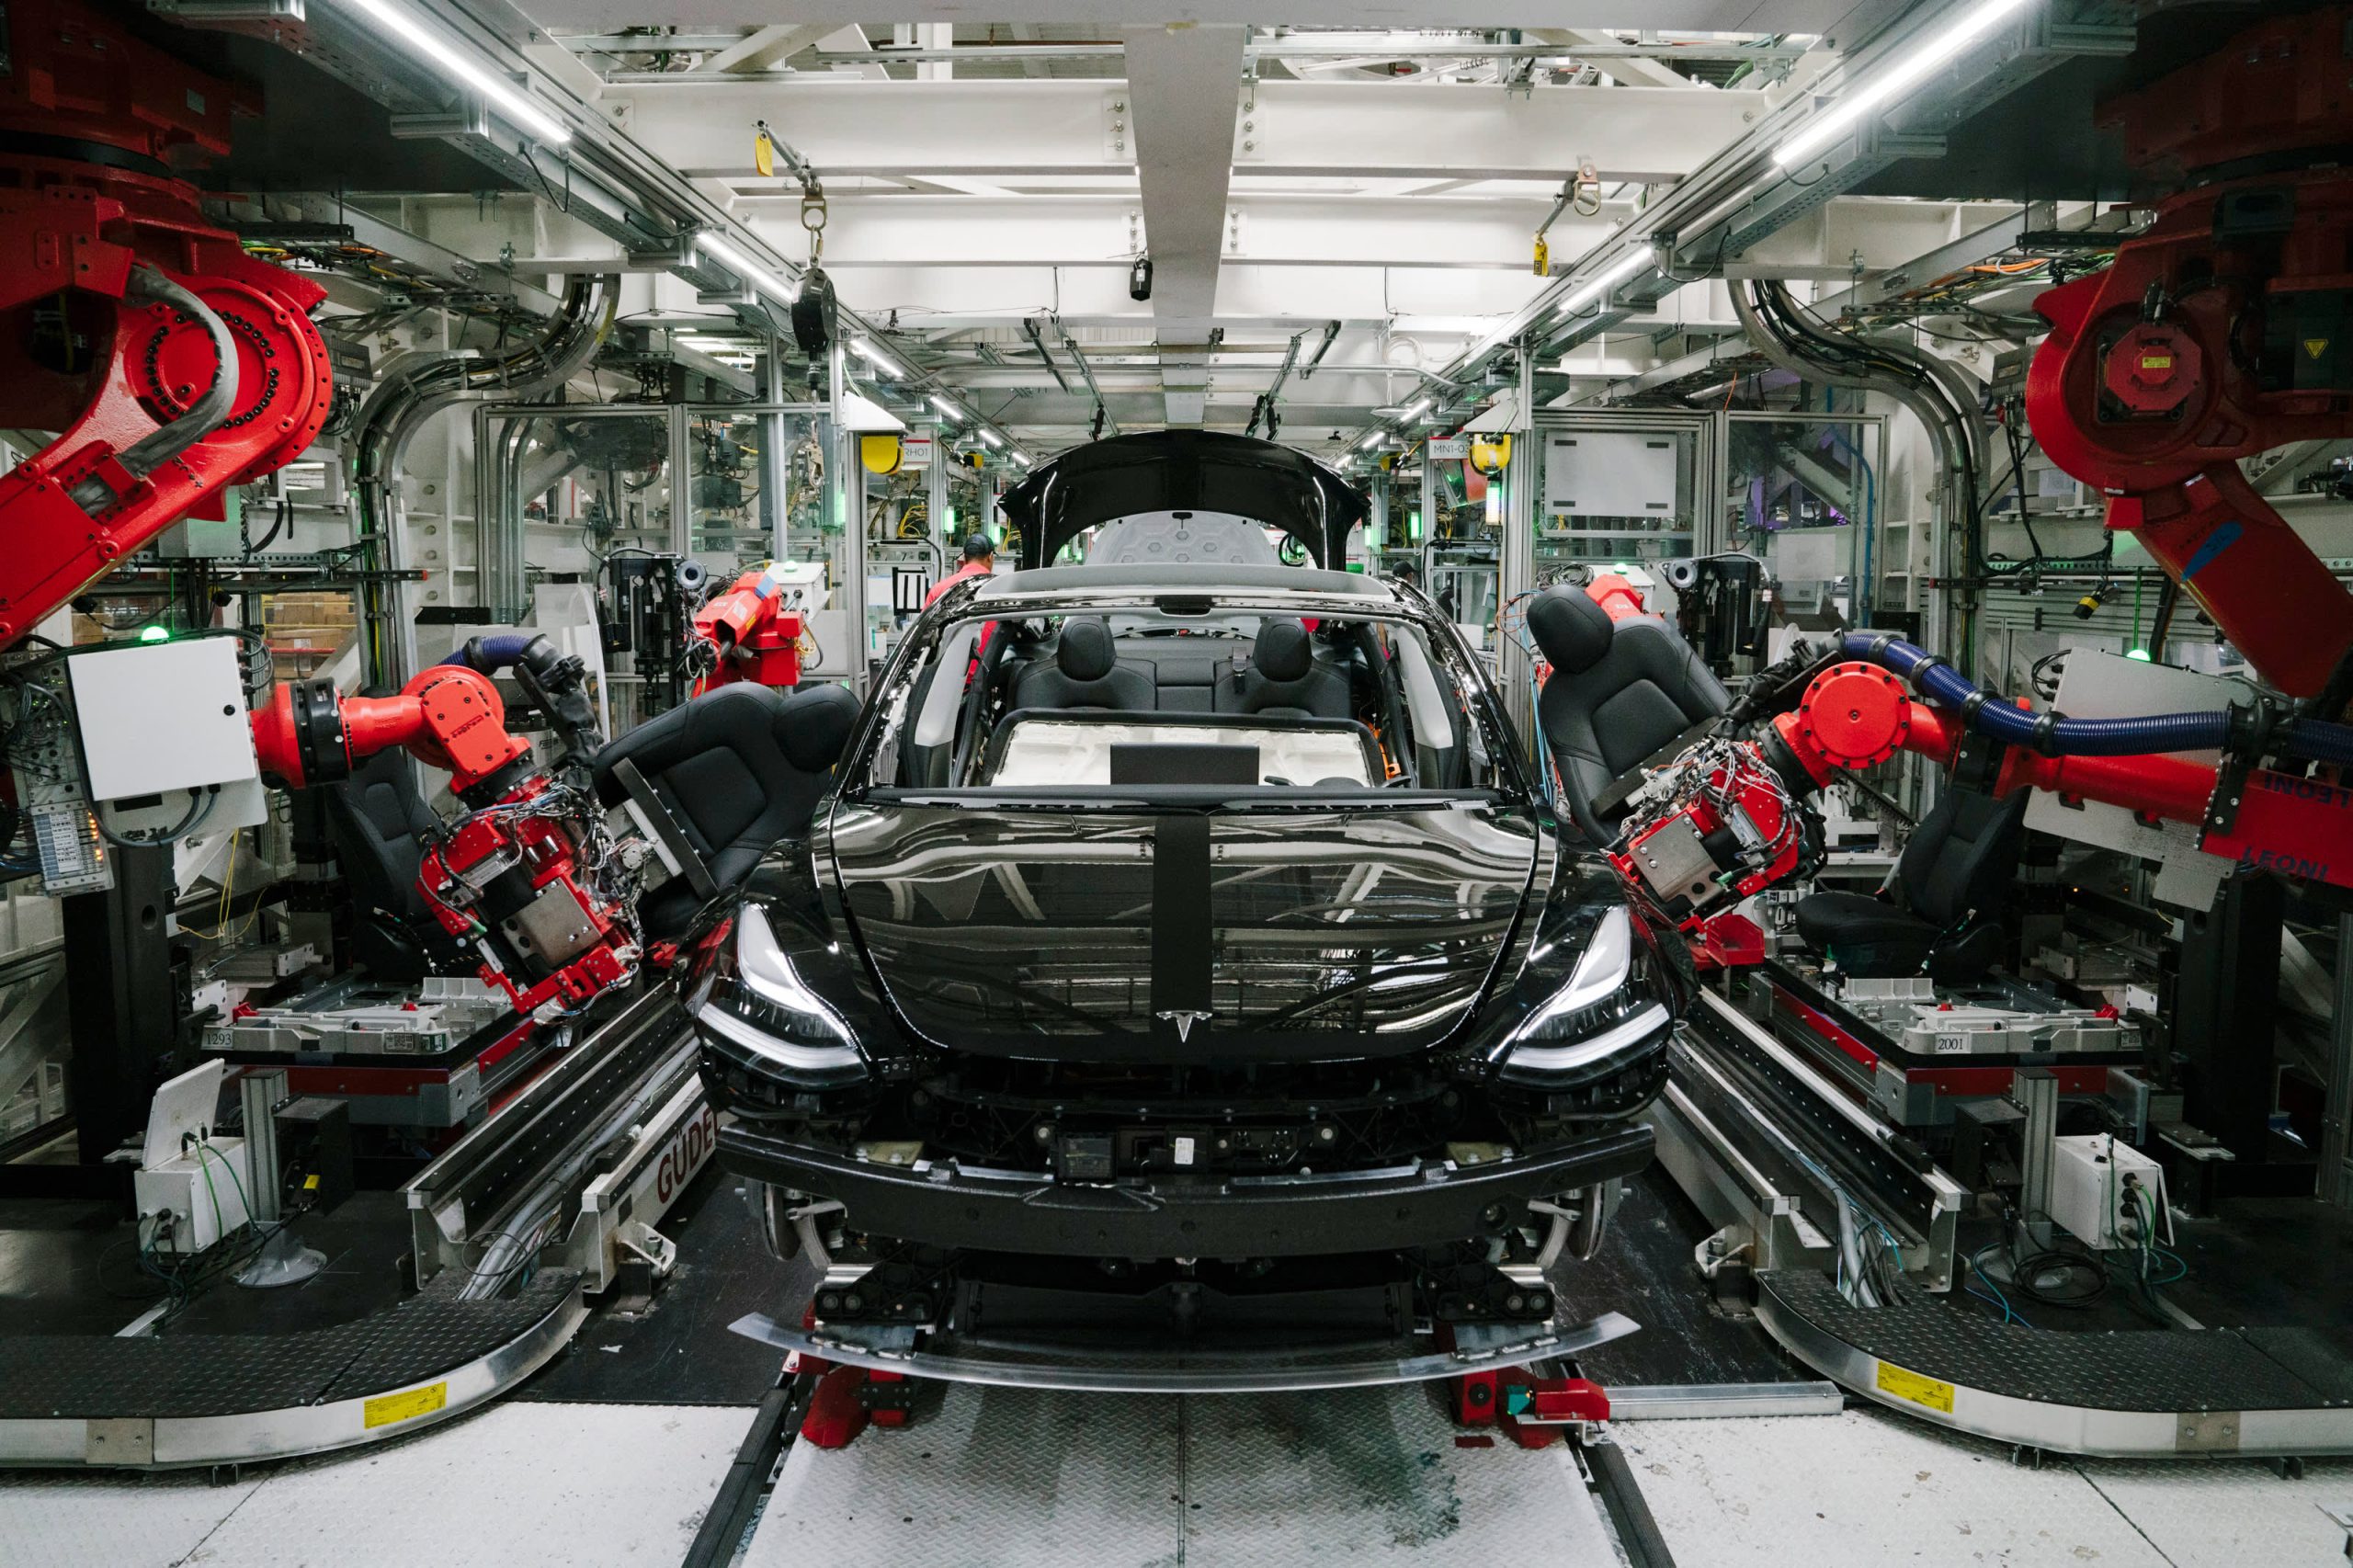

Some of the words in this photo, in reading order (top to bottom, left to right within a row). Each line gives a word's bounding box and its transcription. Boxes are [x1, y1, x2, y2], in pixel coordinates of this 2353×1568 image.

[2264, 772, 2350, 809] LEONI
[2242, 845, 2329, 881] LEONI
[207, 1033, 232, 1045] 1293
[1938, 1038, 1963, 1051] 2001
